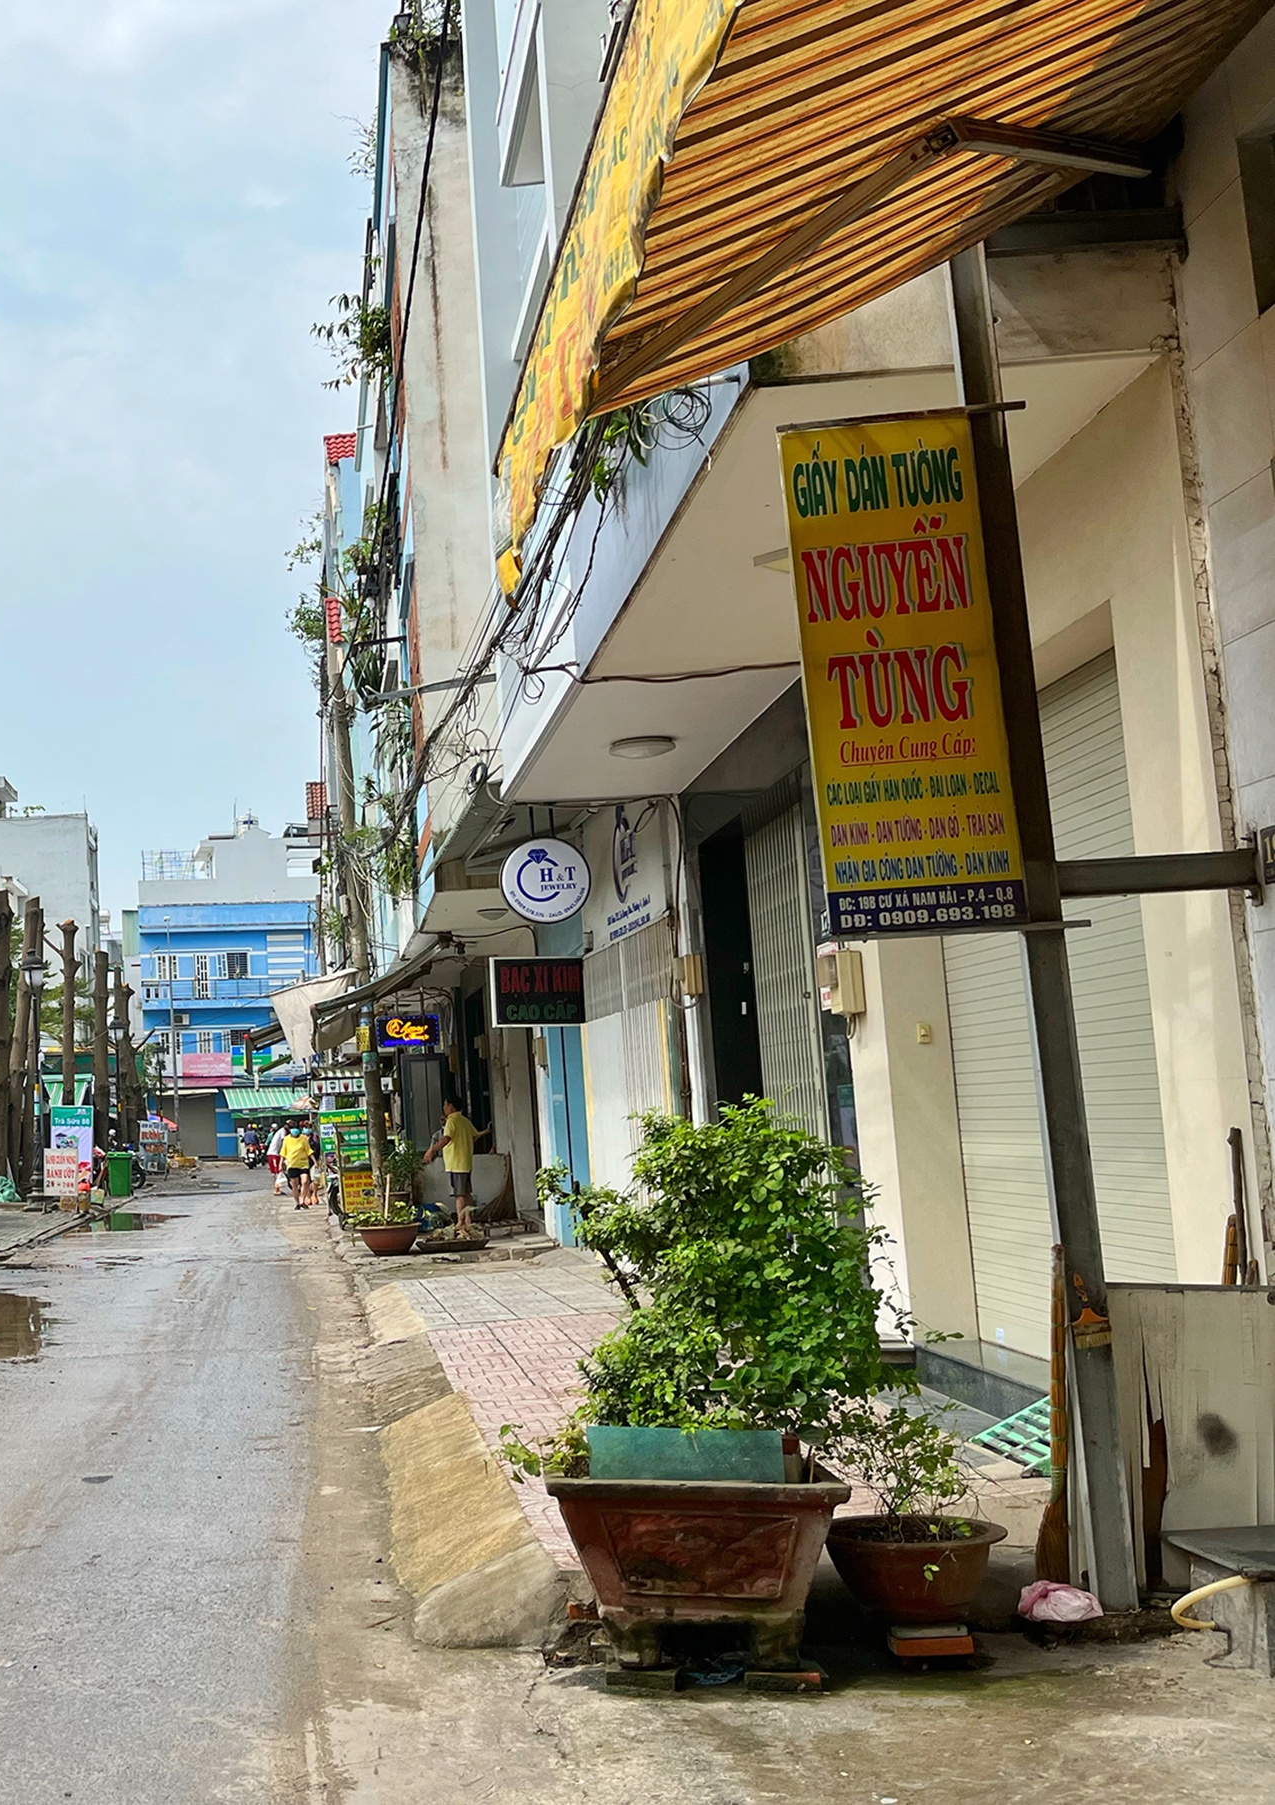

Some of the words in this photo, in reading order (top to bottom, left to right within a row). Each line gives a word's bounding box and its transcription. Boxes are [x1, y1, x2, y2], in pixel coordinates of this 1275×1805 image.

[793, 441, 837, 518] GIẤY
[844, 444, 890, 513] DÁN
[891, 438, 964, 508] TƯỜNG
[801, 514, 971, 624] NGUYỄN
[827, 628, 972, 730] TÙNG
[840, 739, 895, 766] Chuyên
[899, 736, 938, 762] Cung
[942, 729, 976, 760] Cấp:
[827, 777, 842, 806] CÁC
[843, 782, 862, 809] LOẠI
[864, 771, 881, 803] GIẤY
[883, 773, 900, 802] HÀN
[901, 767, 923, 804] QUỐC
[945, 773, 967, 797] LOAN
[972, 771, 1000, 795] DECAL
[830, 818, 848, 847] DÁN
[849, 817, 869, 846] KÍNH
[876, 815, 894, 843] DÁN
[894, 813, 922, 842] TƯỜNG
[928, 810, 946, 840] DÁN
[539, 867, 553, 883] H
[565, 866, 576, 881] T
[835, 855, 860, 888] NHẬN
[862, 859, 877, 882] GIA
[879, 852, 903, 881] CÔNG
[905, 850, 925, 879] DÁN
[926, 848, 958, 877] TƯỜNG
[965, 846, 985, 875] DÁN
[986, 844, 1010, 874] KÍNH
[540, 883, 577, 892] JEWELRY
[839, 897, 856, 911] ĐC:
[858, 895, 876, 910] 19B
[878, 892, 892, 909] CƯ
[912, 890, 937, 906] NAM
[939, 886, 957, 904] HẢI
[967, 888, 985, 902] P.4
[996, 886, 1013, 903] Q.8
[840, 913, 873, 929] DĐ:
[879, 903, 1016, 926] 0909.693.198
[500, 966, 530, 998] BẠC
[534, 965, 549, 992] XI
[552, 965, 580, 992] KIM
[505, 1004, 541, 1020] CAO
[543, 998, 578, 1020] CẤP
[54, 1117, 65, 1125] Trà
[67, 1117, 80, 1125] Sữa
[81, 1117, 90, 1125] 88
[46, 1167, 62, 1178] BÁNH
